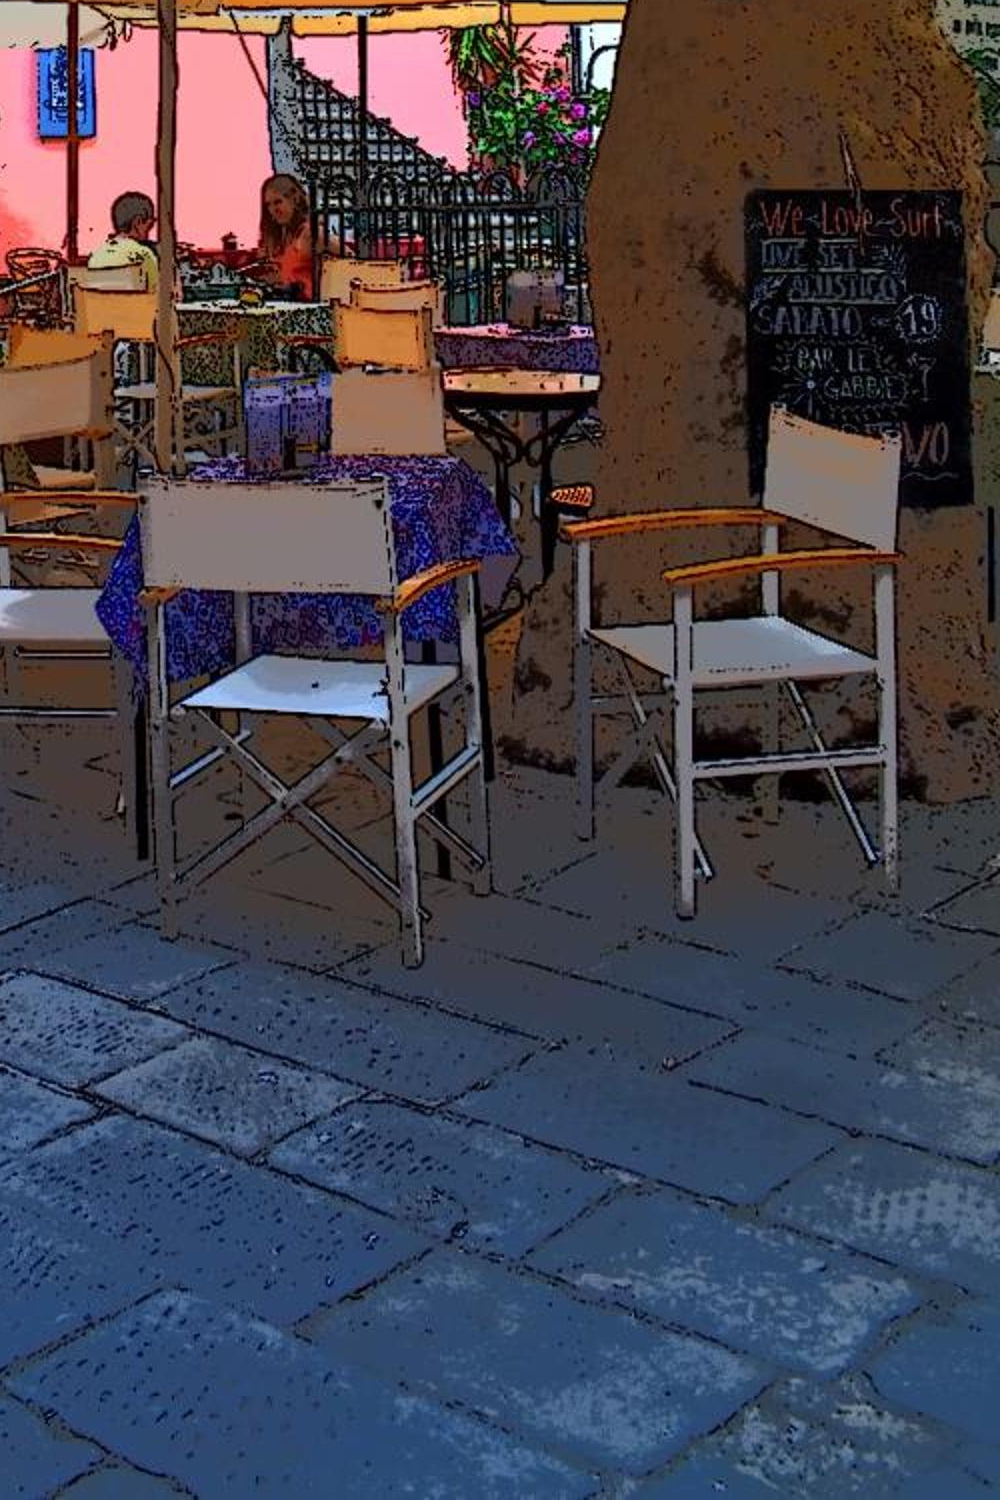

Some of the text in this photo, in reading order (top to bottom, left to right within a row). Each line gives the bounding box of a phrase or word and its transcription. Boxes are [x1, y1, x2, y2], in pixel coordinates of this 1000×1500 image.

[760, 197, 944, 240] We Love Surf
[818, 243, 857, 269] SET
[788, 274, 898, 301] ACUSTICO
[755, 302, 938, 337] SABATO 19
